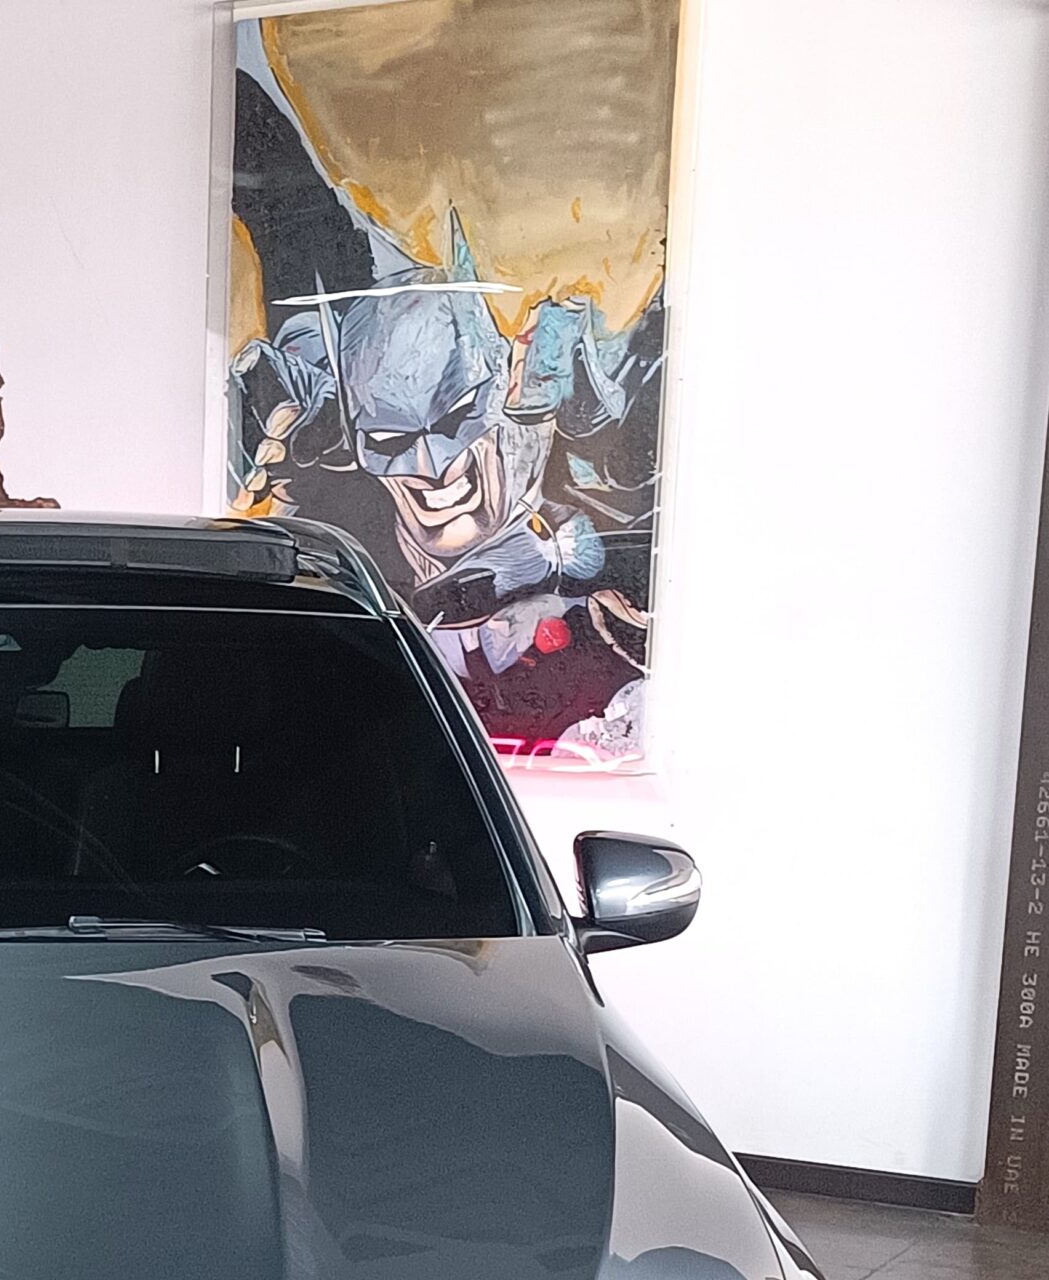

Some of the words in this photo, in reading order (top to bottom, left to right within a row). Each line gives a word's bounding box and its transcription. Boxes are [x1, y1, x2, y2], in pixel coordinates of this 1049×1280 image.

[1024, 931, 1042, 957] HE
[1018, 972, 1038, 1029] 300A
[1012, 1044, 1032, 1098] MADE
[1010, 1115, 1026, 1141] IN
[1004, 1155, 1022, 1194] UAE
